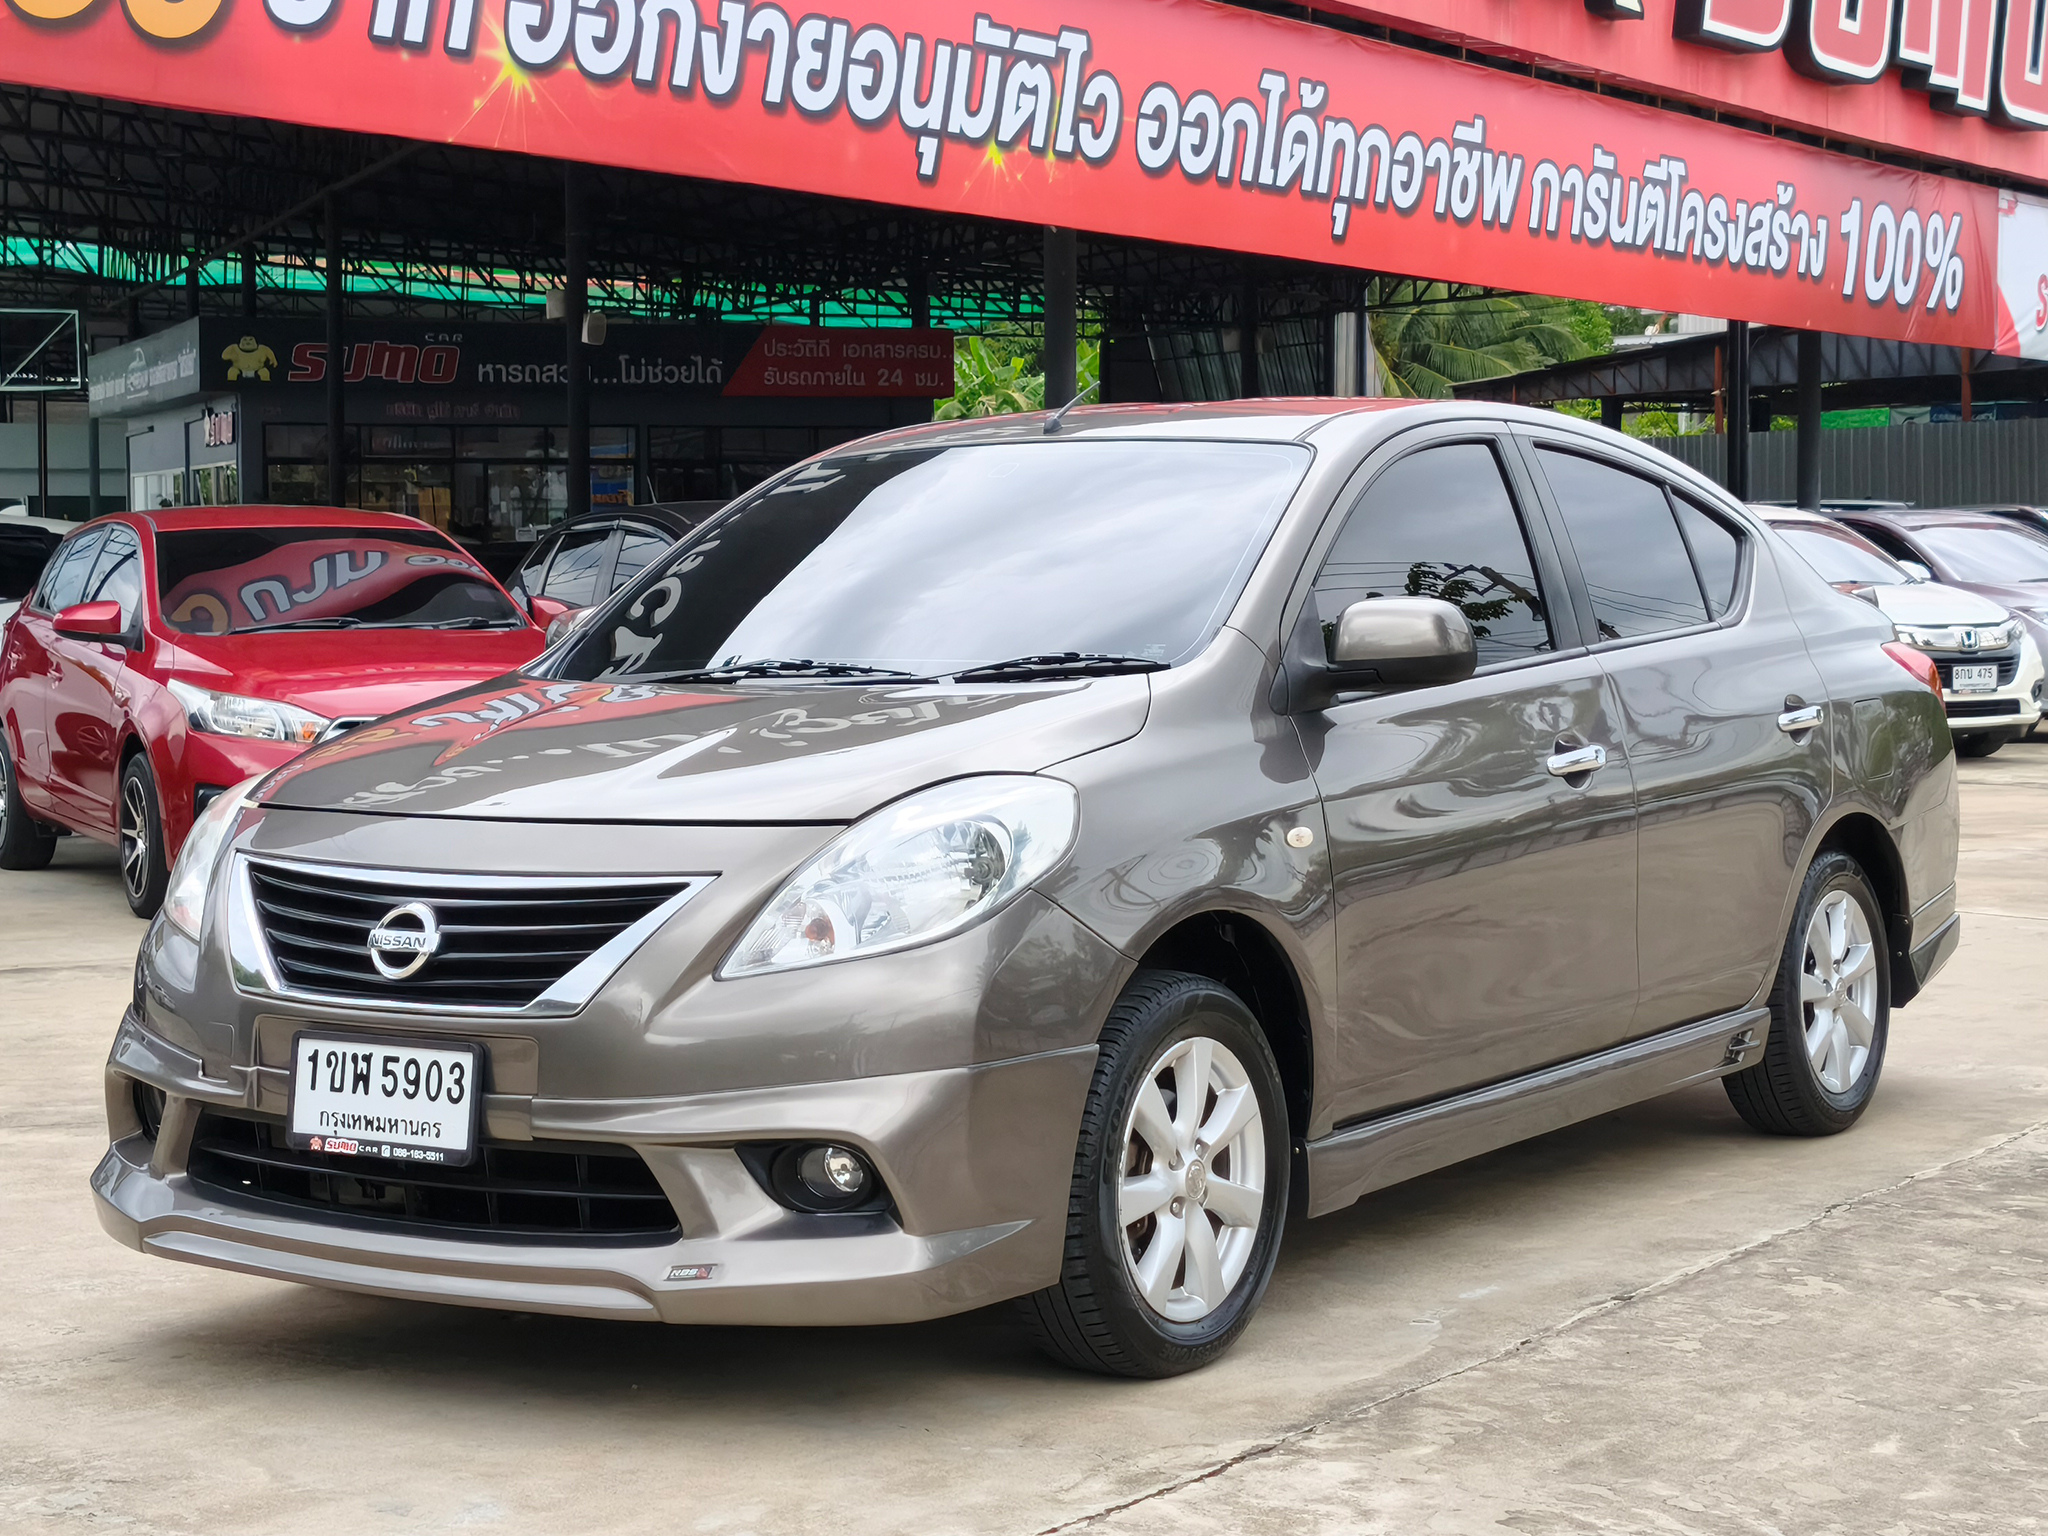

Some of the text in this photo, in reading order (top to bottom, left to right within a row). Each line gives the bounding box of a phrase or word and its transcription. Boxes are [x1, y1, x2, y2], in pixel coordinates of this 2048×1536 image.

[1137, 70, 1523, 238] ออกได้ทุกอาชีพ
[1530, 145, 1829, 279] การันตีโครงสร้าง
[1840, 199, 1965, 312] 100%
[424, 333, 464, 343] CAR
[763, 364, 944, 387] รับรถภายใน 24 ชม.
[372, 933, 427, 948] NISSAN
[381, 1055, 466, 1105] 5903
[319, 1110, 442, 1139] กรุงเทพมหานคร
[358, 1145, 379, 1154] CAR
